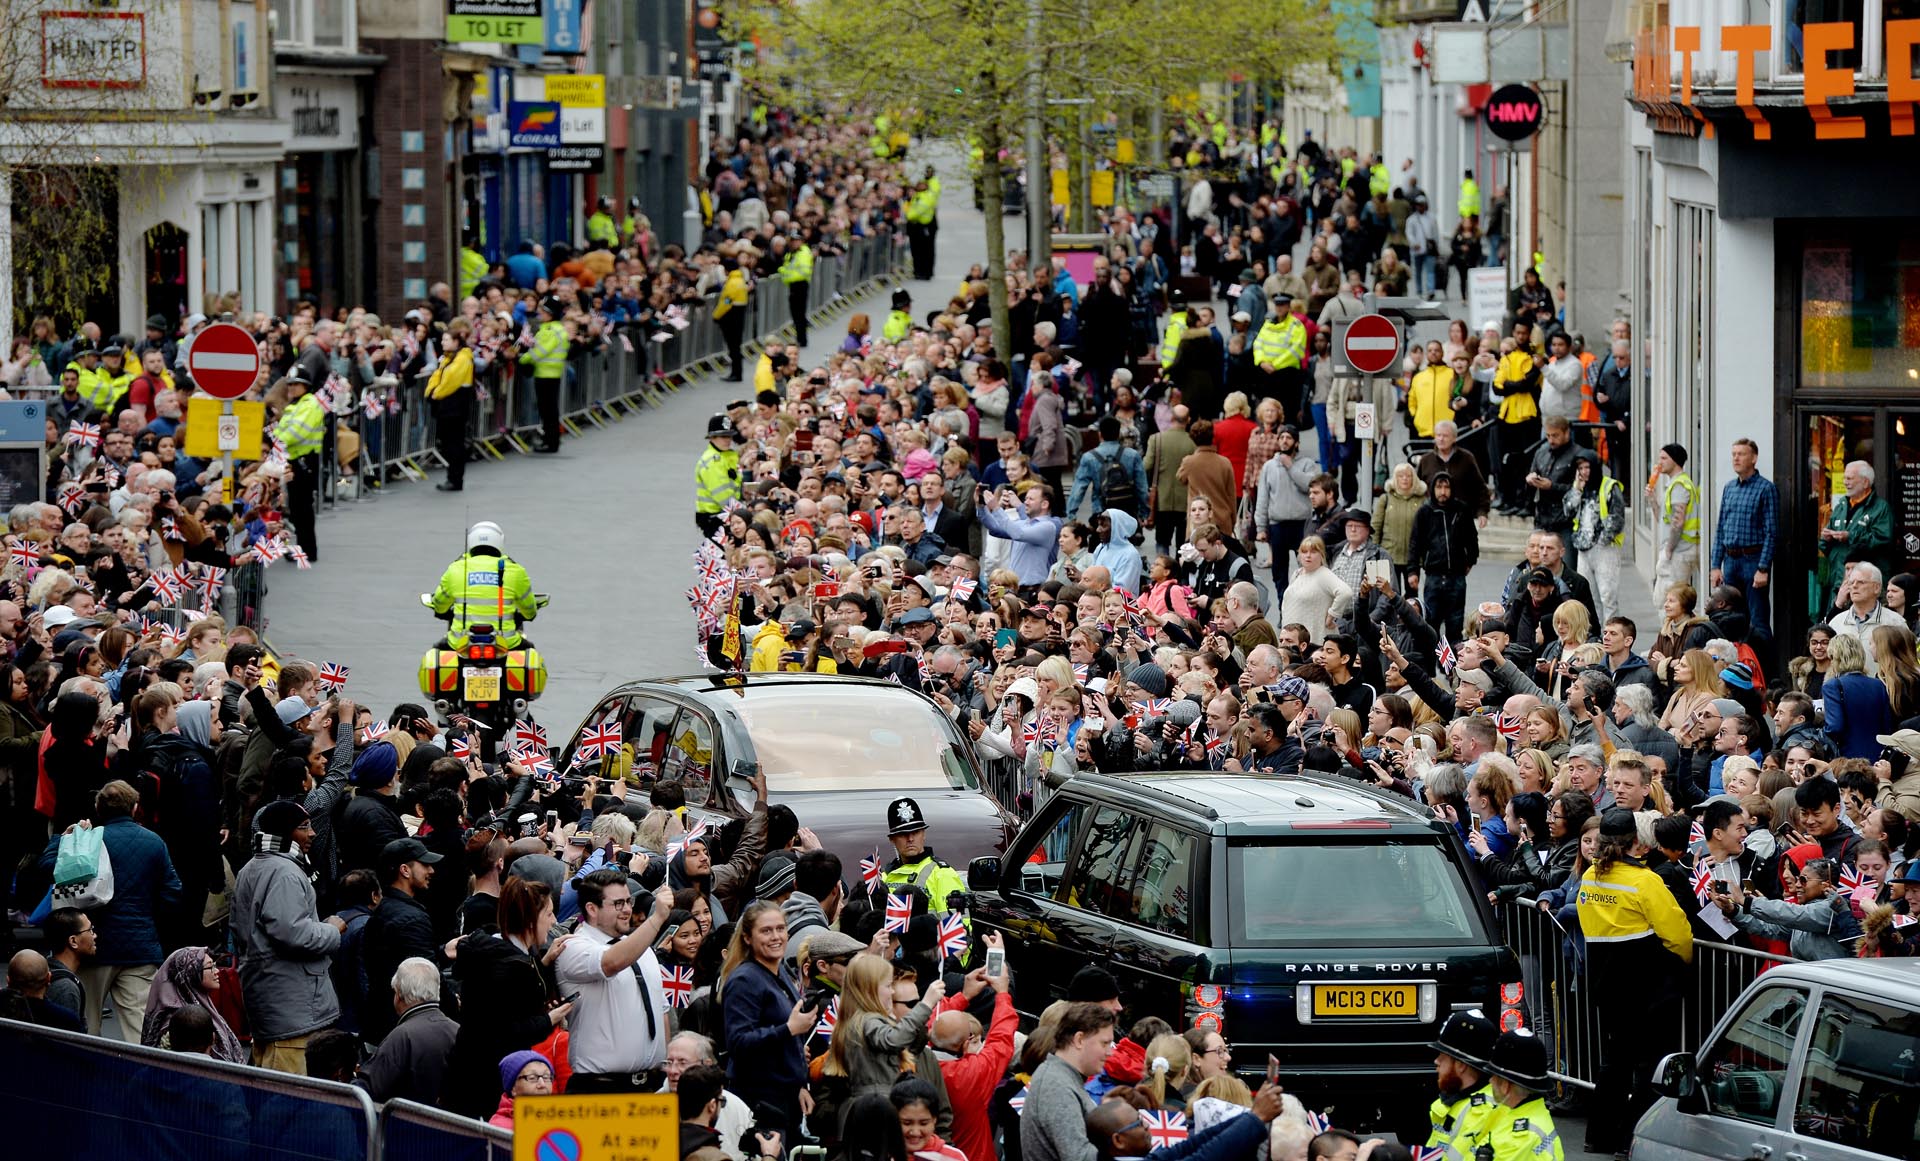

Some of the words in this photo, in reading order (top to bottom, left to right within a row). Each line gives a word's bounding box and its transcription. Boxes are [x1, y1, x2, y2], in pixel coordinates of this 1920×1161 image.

[466, 20, 490, 37] TO
[496, 21, 526, 37] LET
[51, 38, 137, 59] HUNTER
[1489, 102, 1538, 122] HMV
[575, 119, 594, 133] Let
[512, 134, 559, 144] CORAL
[469, 573, 499, 584] POLICE
[467, 678, 497, 689] FJ58
[471, 689, 493, 699] NJV
[1285, 964, 1359, 973] RANGE
[1375, 963, 1448, 971] ROVER
[1326, 991, 1365, 1008] MC13
[1371, 991, 1405, 1008] CKO
[523, 1104, 621, 1120] Pedestrian
[627, 1102, 671, 1117] Zone
[602, 1133, 621, 1147] At
[629, 1136, 661, 1150] any
